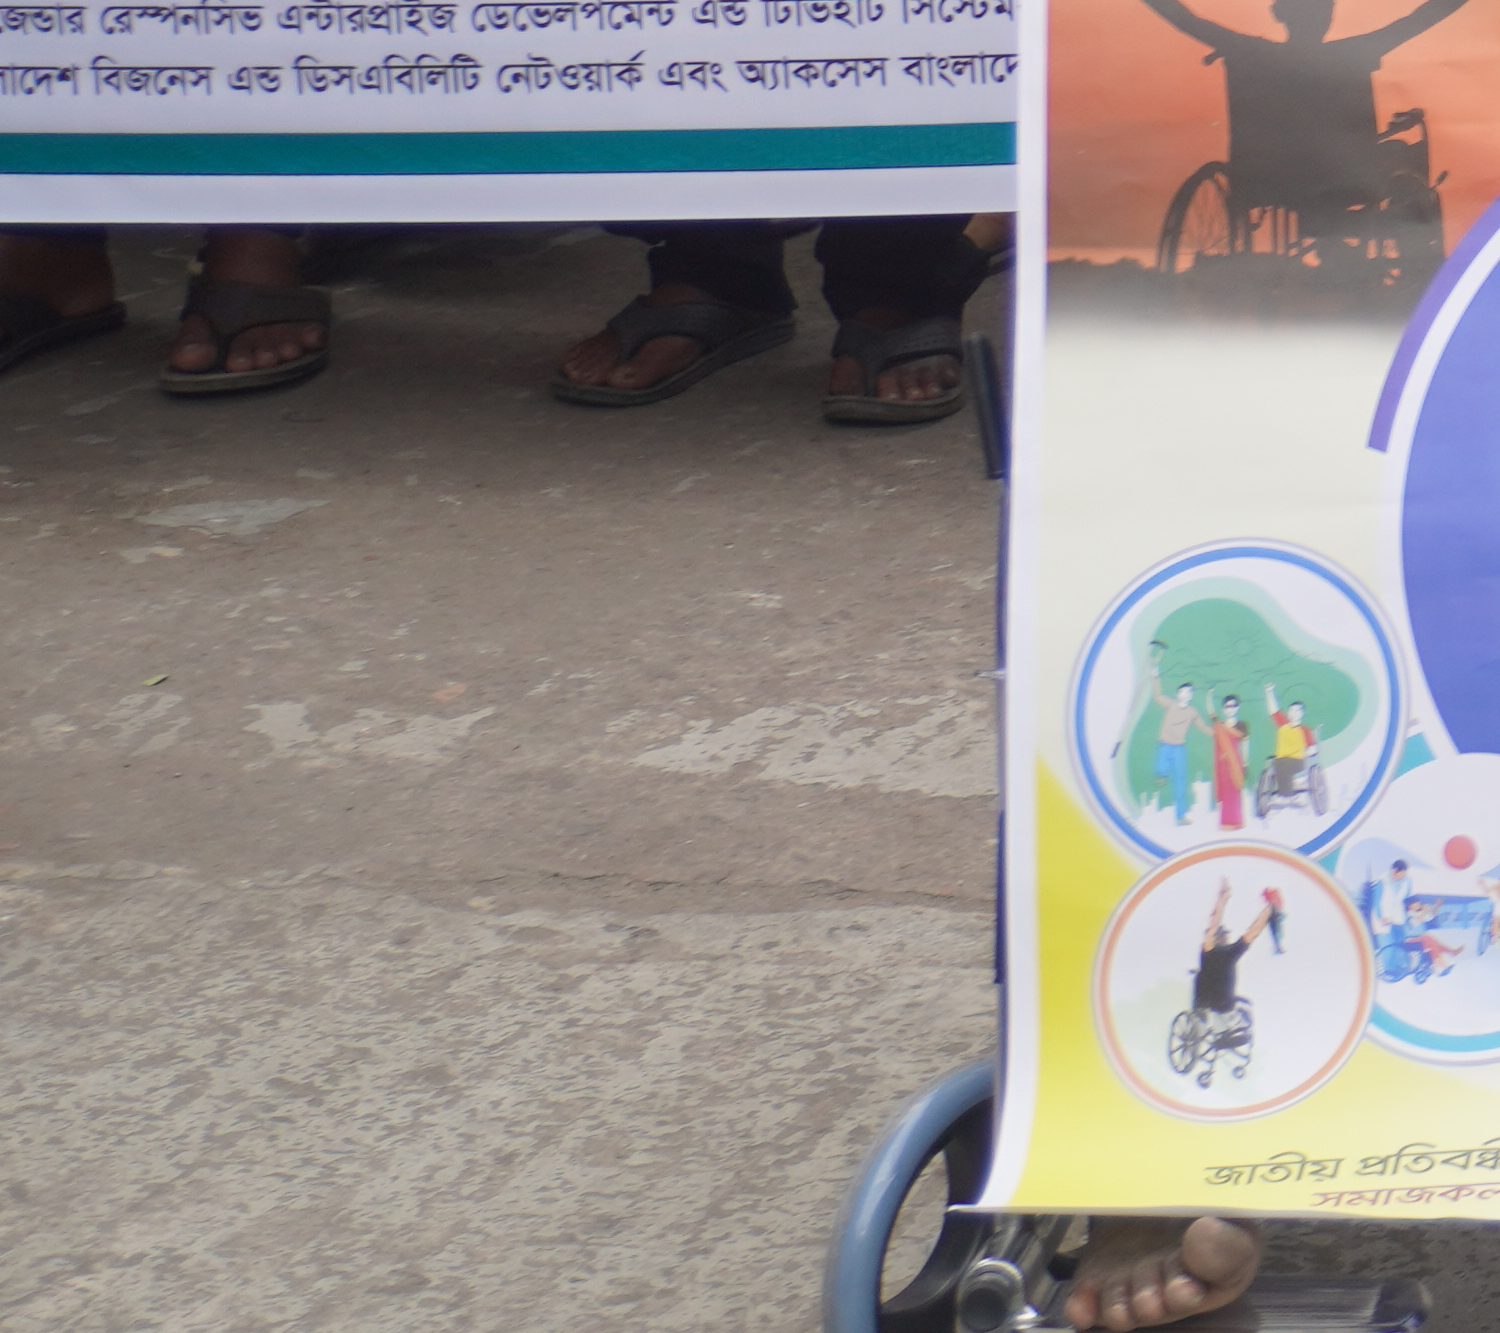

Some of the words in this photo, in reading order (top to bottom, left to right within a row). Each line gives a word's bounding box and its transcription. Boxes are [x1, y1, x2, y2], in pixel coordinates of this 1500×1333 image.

[91, 55, 216, 96] বিজনেস
[497, 50, 646, 93] নেটওয়ার্ক
[658, 60, 729, 92] এবং
[1204, 1150, 1345, 1188] জাতীয়
